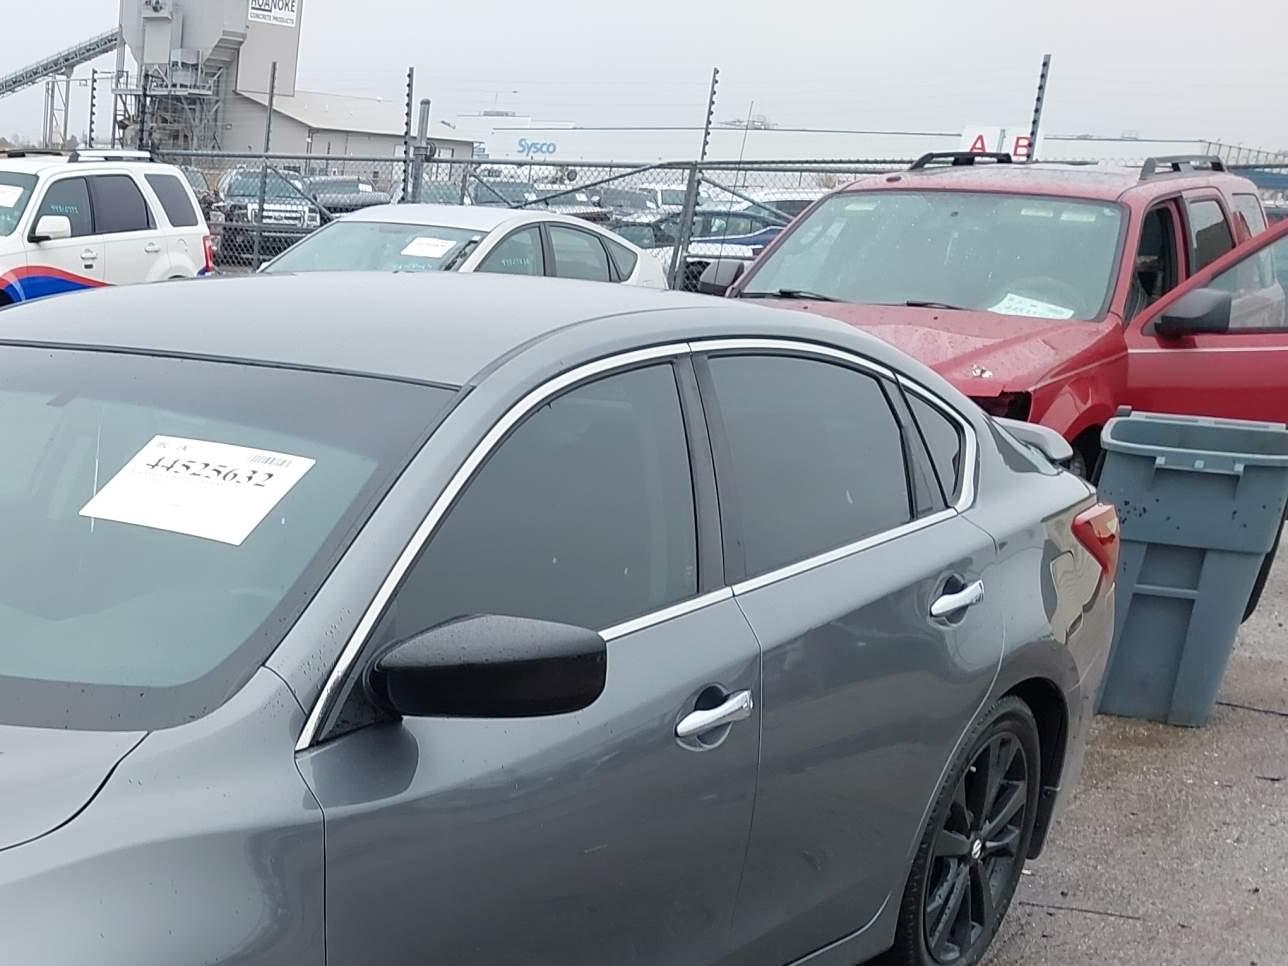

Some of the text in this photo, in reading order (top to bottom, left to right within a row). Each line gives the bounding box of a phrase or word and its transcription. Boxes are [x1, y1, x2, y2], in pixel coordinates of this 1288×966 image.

[517, 138, 556, 157] Sysco
[969, 134, 1032, 157] A B
[146, 456, 274, 488] 44525632
